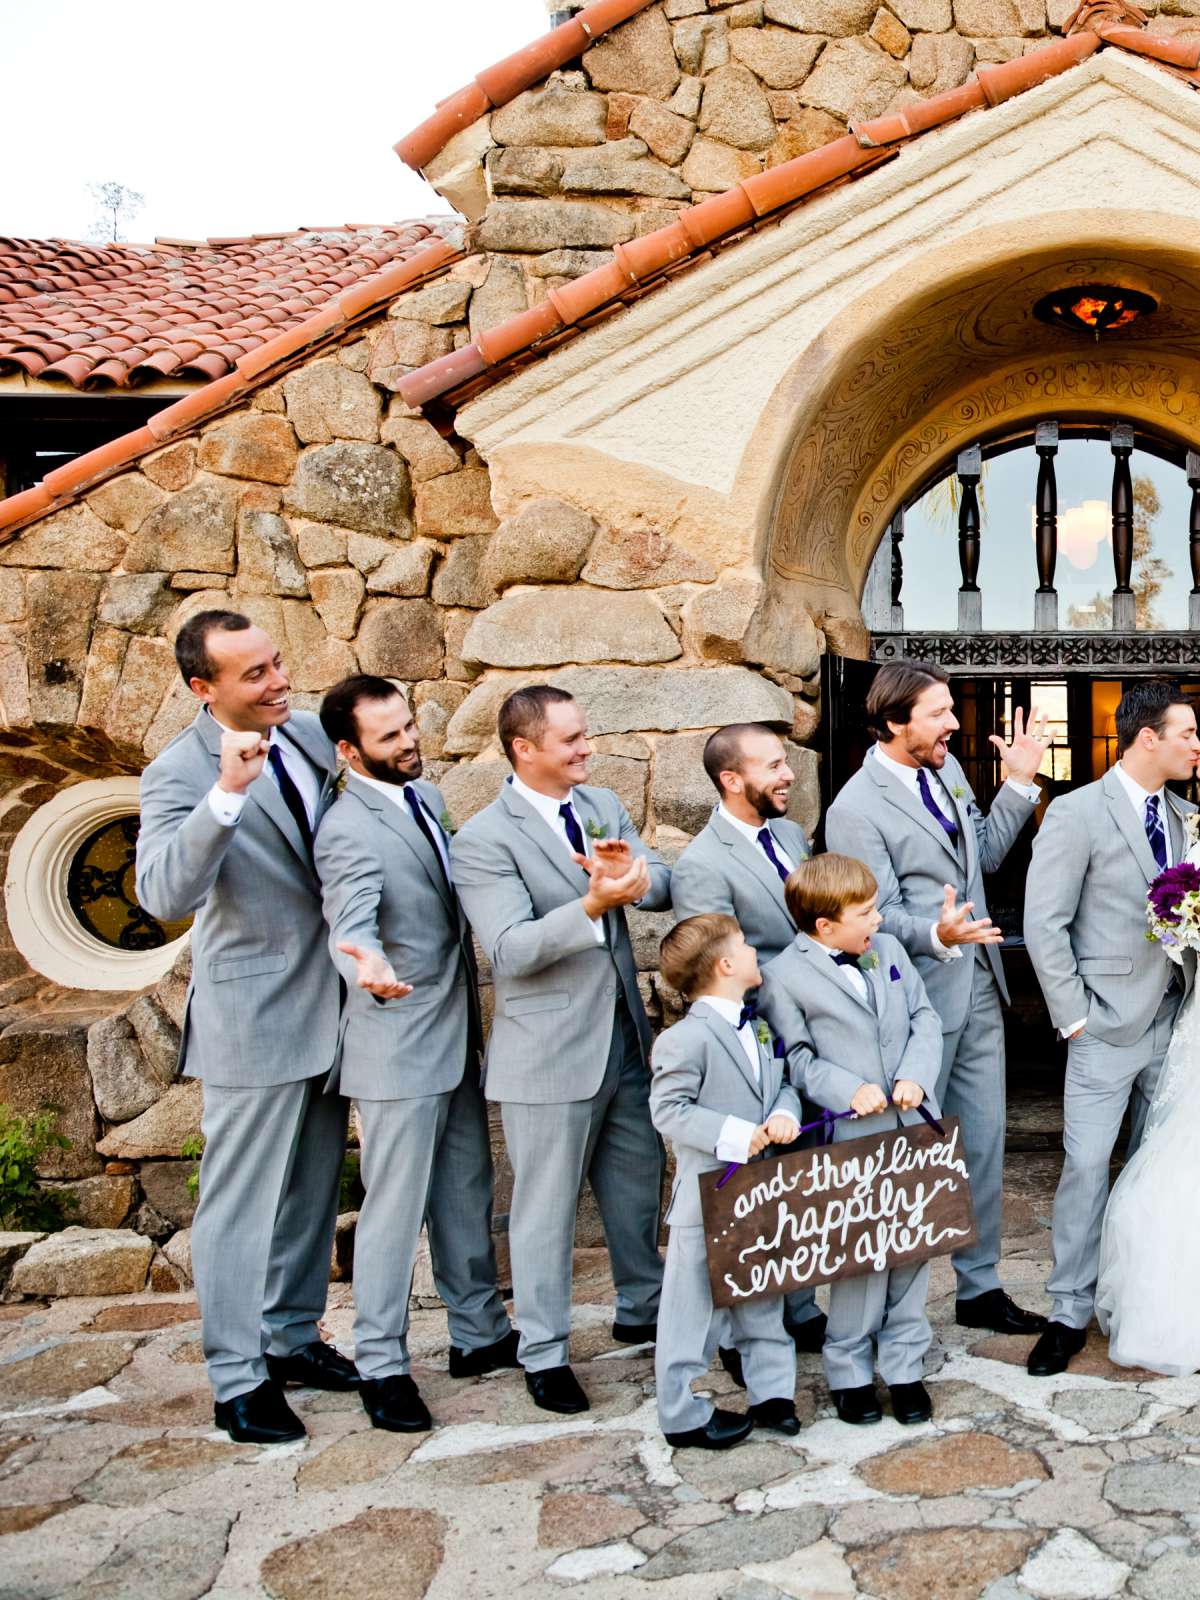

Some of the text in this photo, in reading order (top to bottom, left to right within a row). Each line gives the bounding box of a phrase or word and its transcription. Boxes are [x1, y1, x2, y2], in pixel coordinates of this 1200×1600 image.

[802, 1140, 886, 1198] they
[879, 1125, 970, 1180] lived
[724, 1216, 972, 1298] ever after
[738, 1177, 958, 1264] happily
